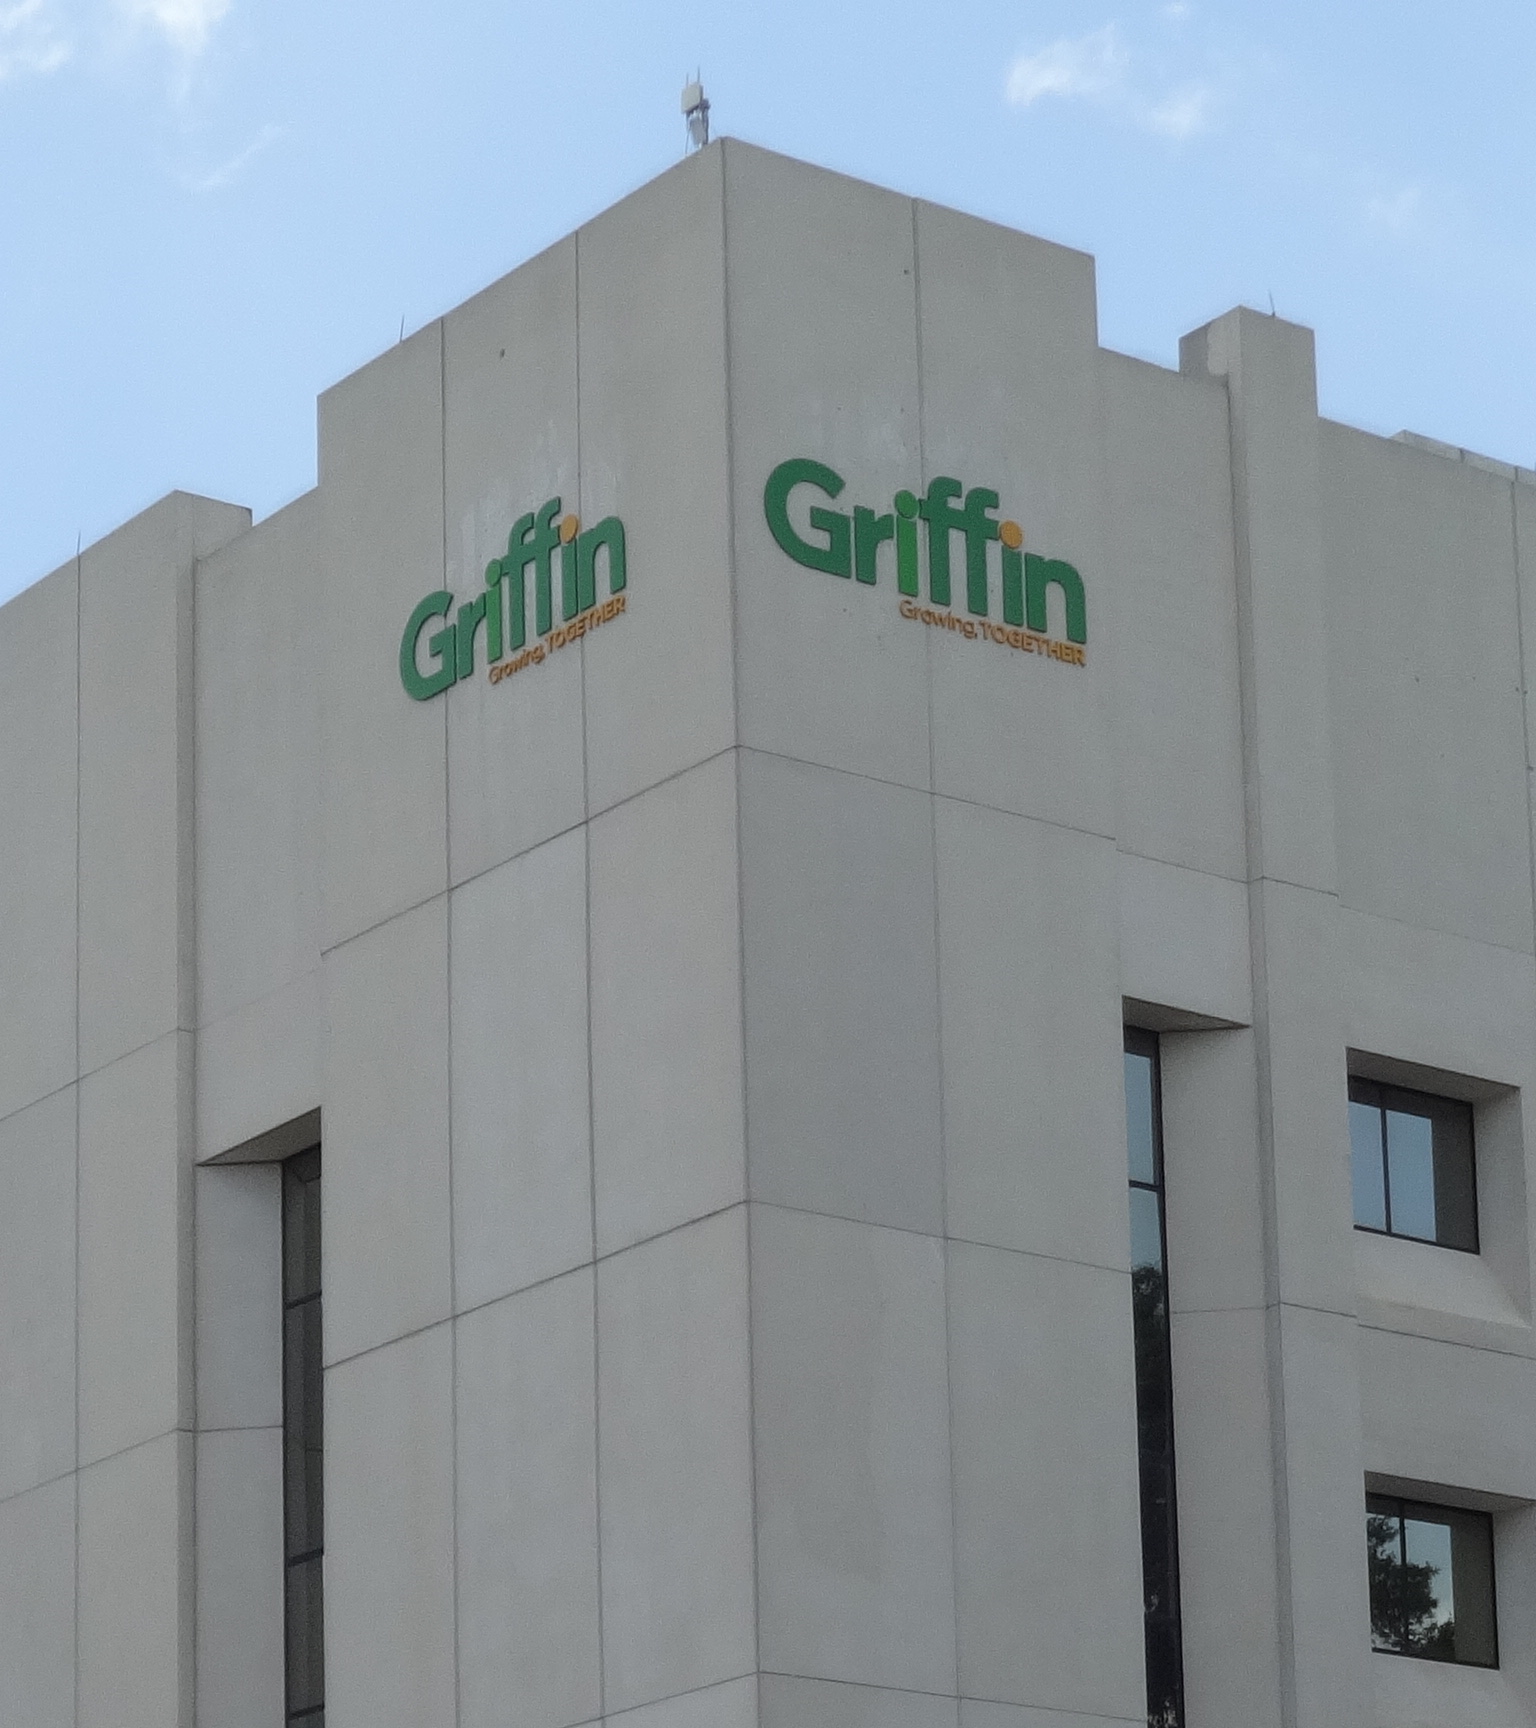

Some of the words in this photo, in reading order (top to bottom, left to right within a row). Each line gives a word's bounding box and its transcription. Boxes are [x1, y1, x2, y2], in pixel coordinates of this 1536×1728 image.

[400, 496, 626, 700] Griffin
[764, 458, 1086, 644] Griffin
[545, 595, 626, 653] TOGETHER
[979, 619, 1086, 668] TOGETHER
